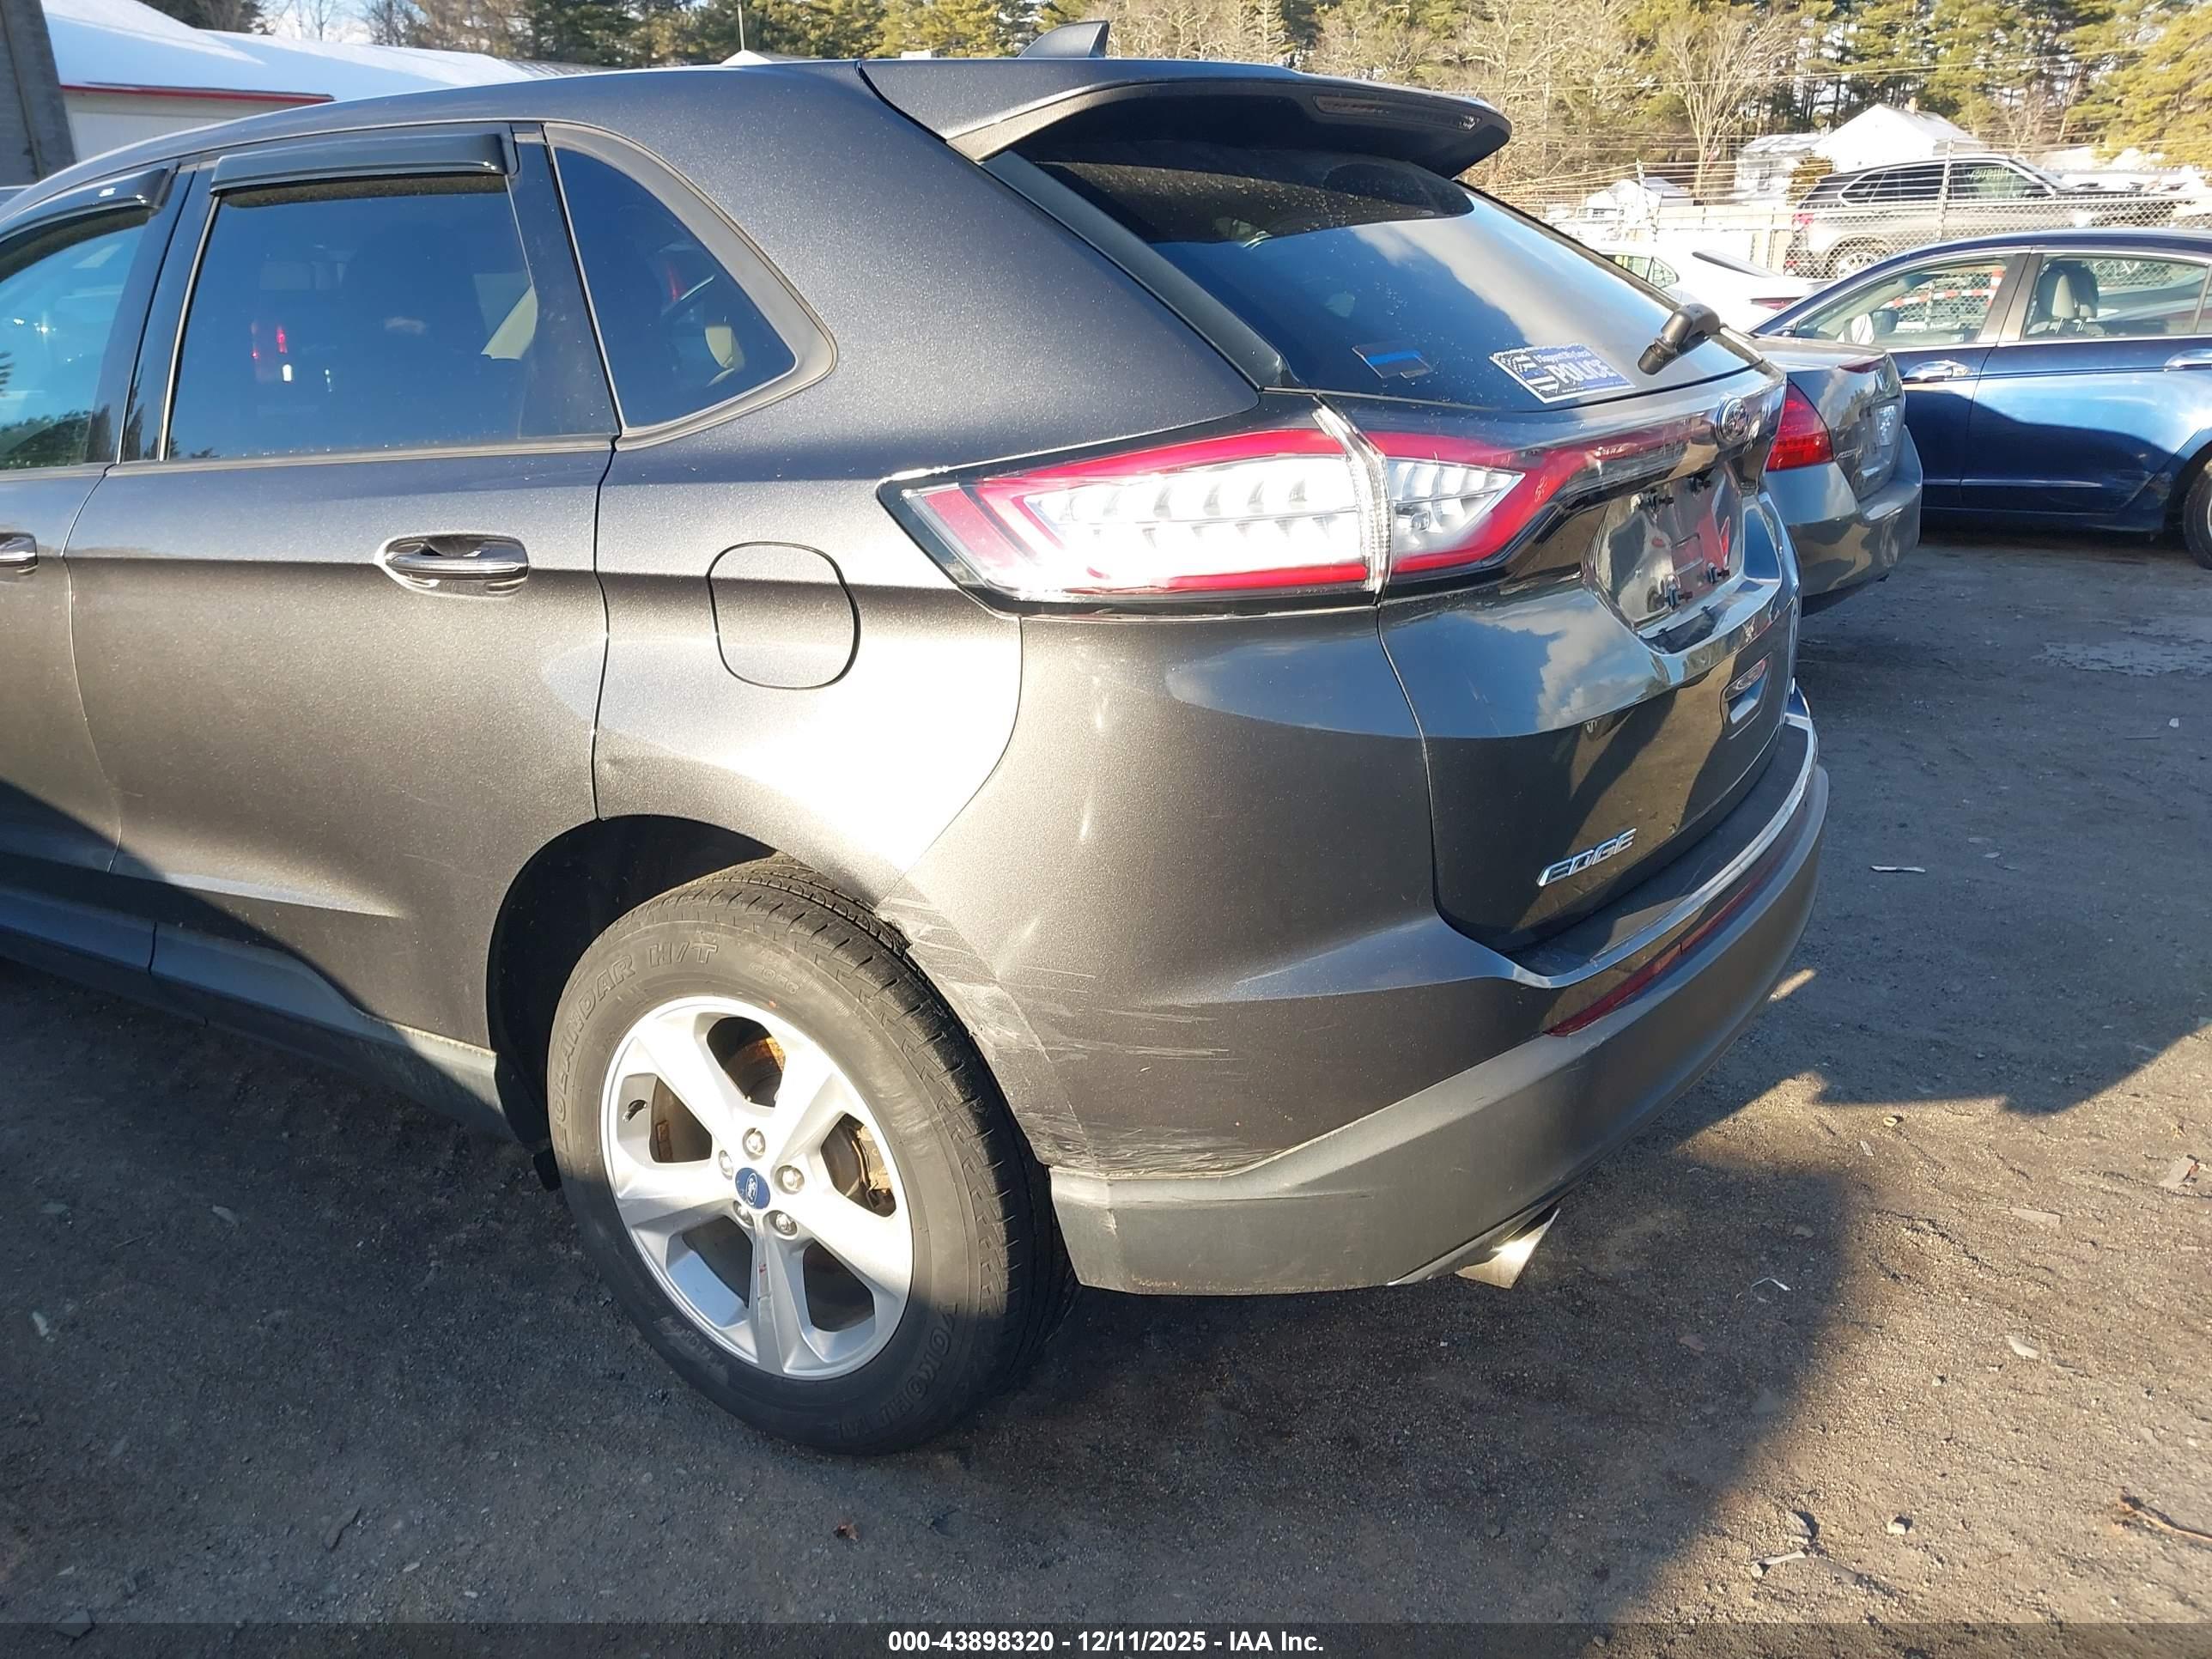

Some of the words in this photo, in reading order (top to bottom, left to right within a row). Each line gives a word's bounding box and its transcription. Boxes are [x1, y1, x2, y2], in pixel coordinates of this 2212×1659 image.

[1543, 358, 1619, 385] POLICE
[1536, 827, 1638, 888] EDGE
[648, 940, 719, 968] H/T
